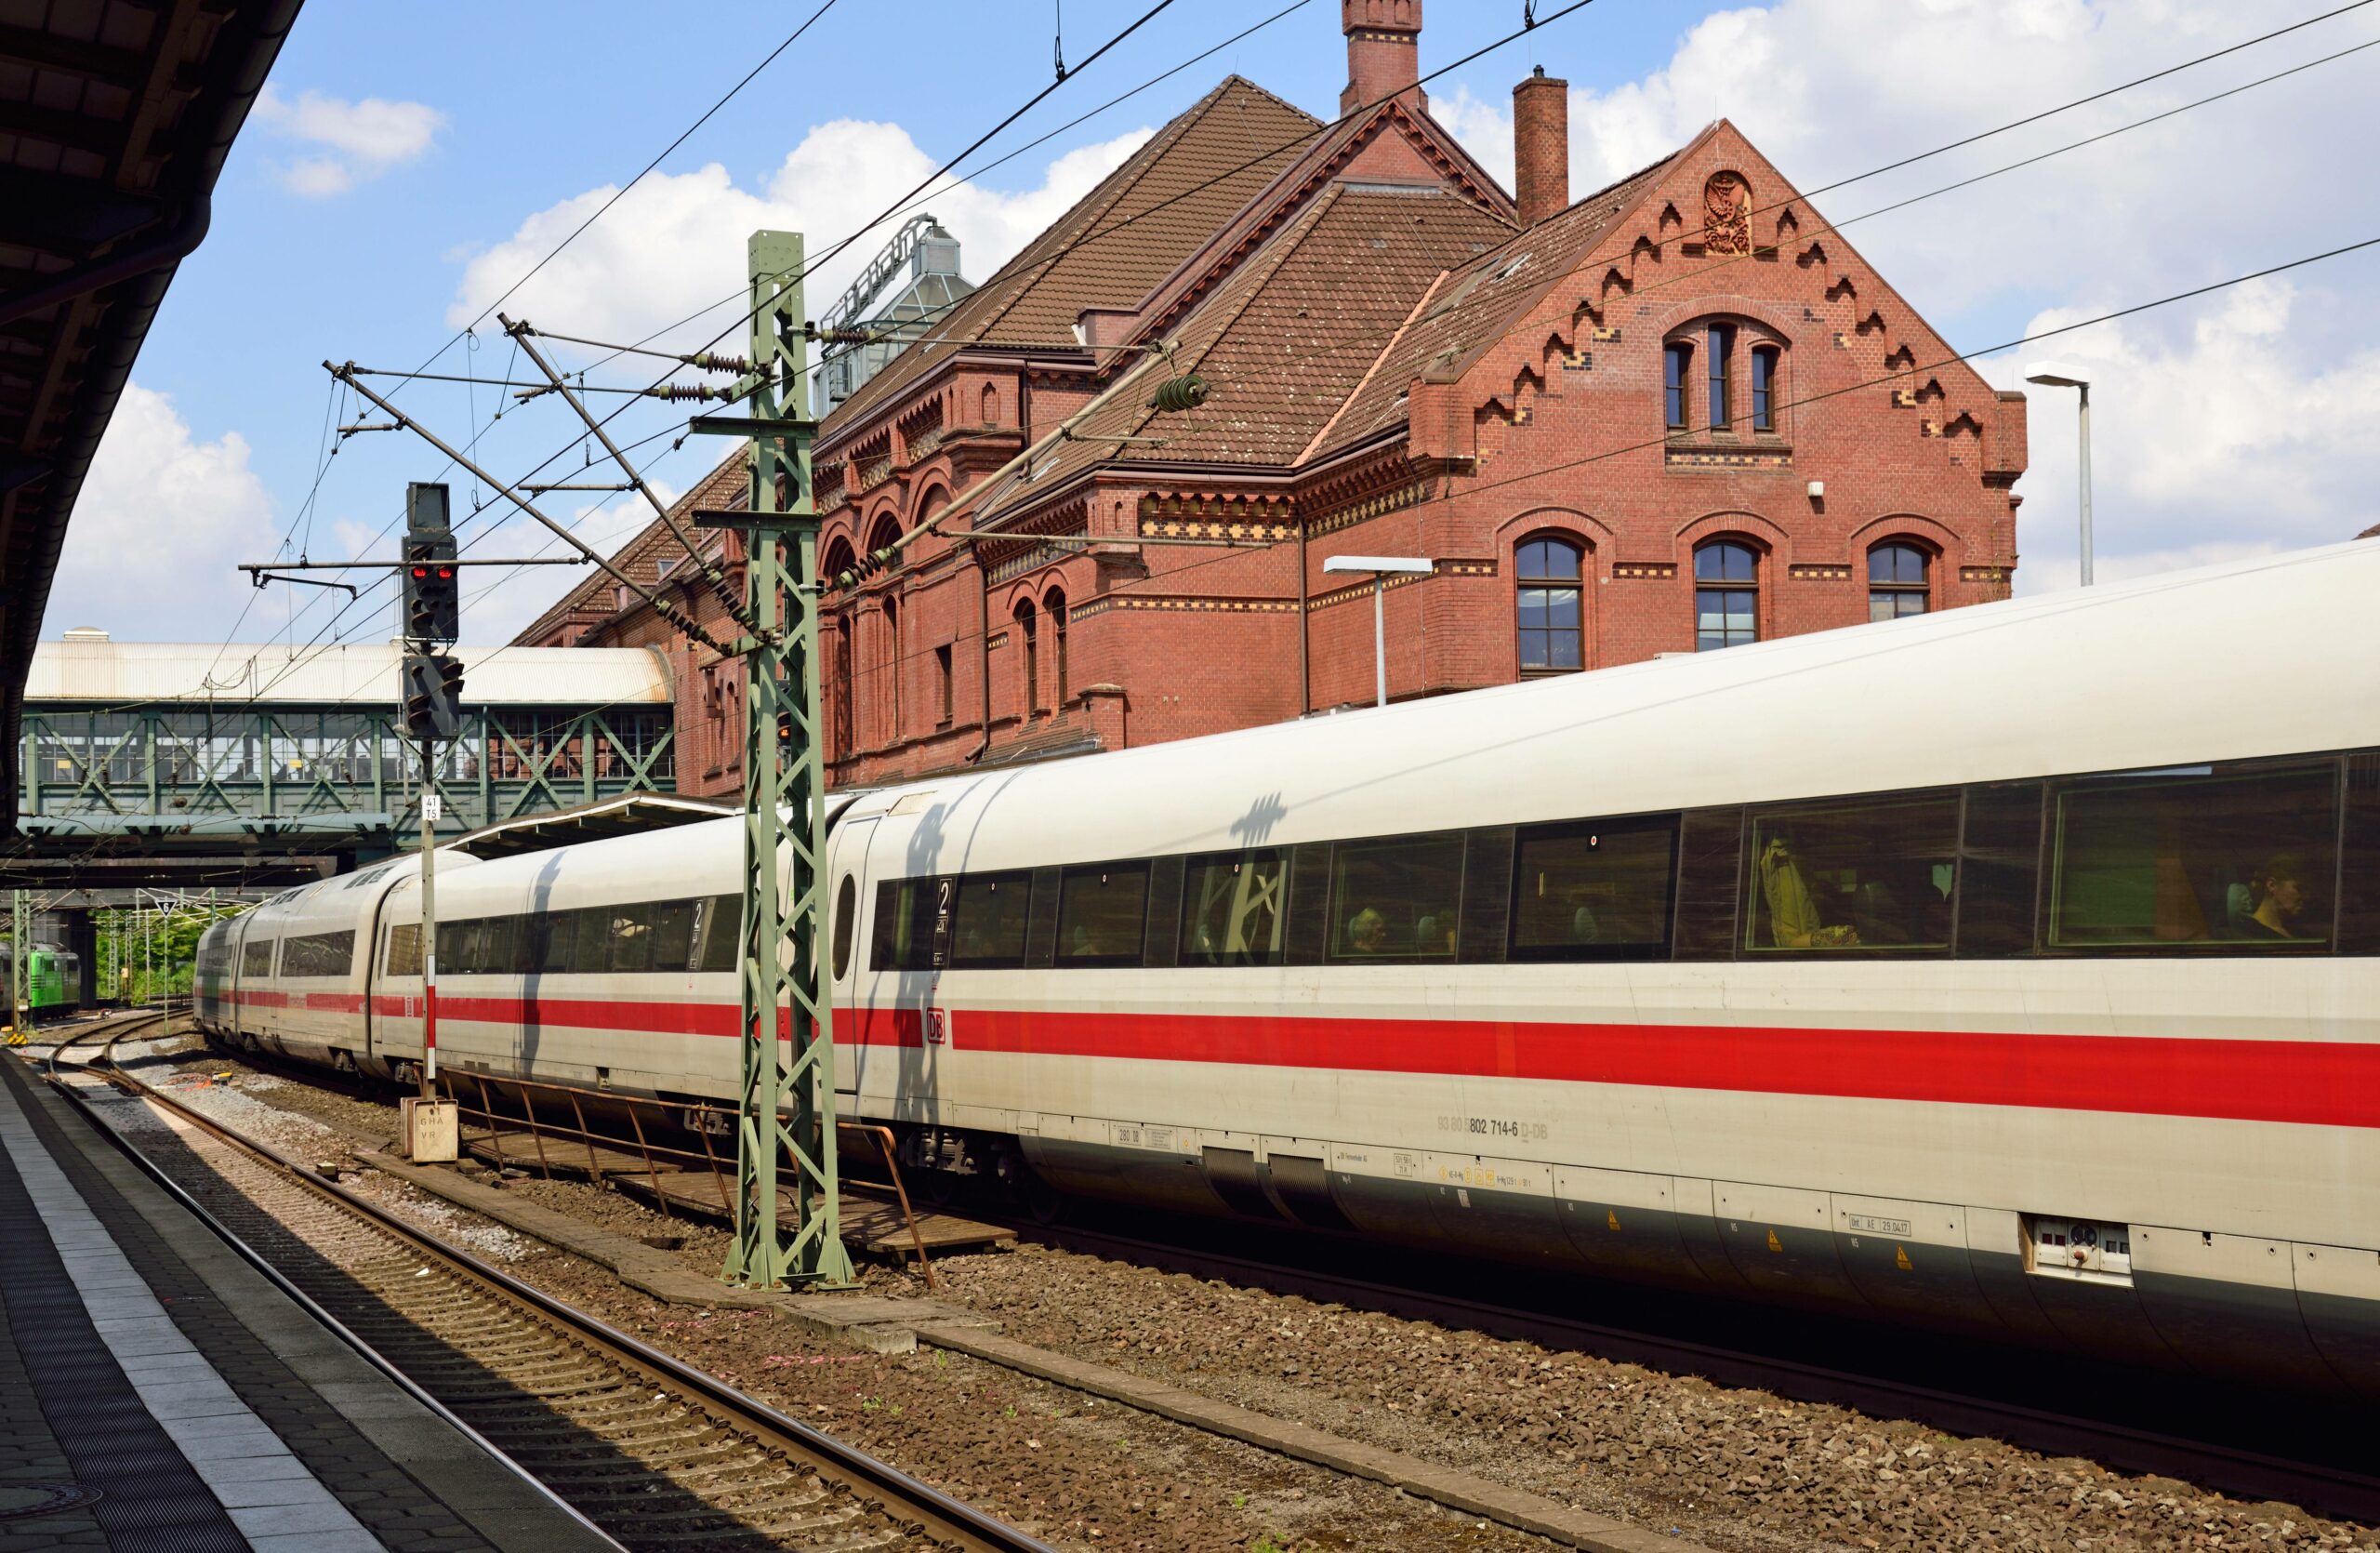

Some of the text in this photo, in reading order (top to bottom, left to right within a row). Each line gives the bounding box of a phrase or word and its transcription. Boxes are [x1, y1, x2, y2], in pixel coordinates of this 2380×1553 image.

[427, 797, 436, 807] 41
[427, 809, 437, 819] T5
[939, 882, 948, 914] 2
[163, 902, 169, 912] 6
[694, 902, 702, 929] 2
[929, 1013, 944, 1039] DB
[420, 1117, 443, 1126] GHA
[421, 1131, 436, 1139] VR
[1490, 1120, 1518, 1137] 714-6
[1521, 1122, 1548, 1141] D-DB
[1867, 1219, 1875, 1229] AE
